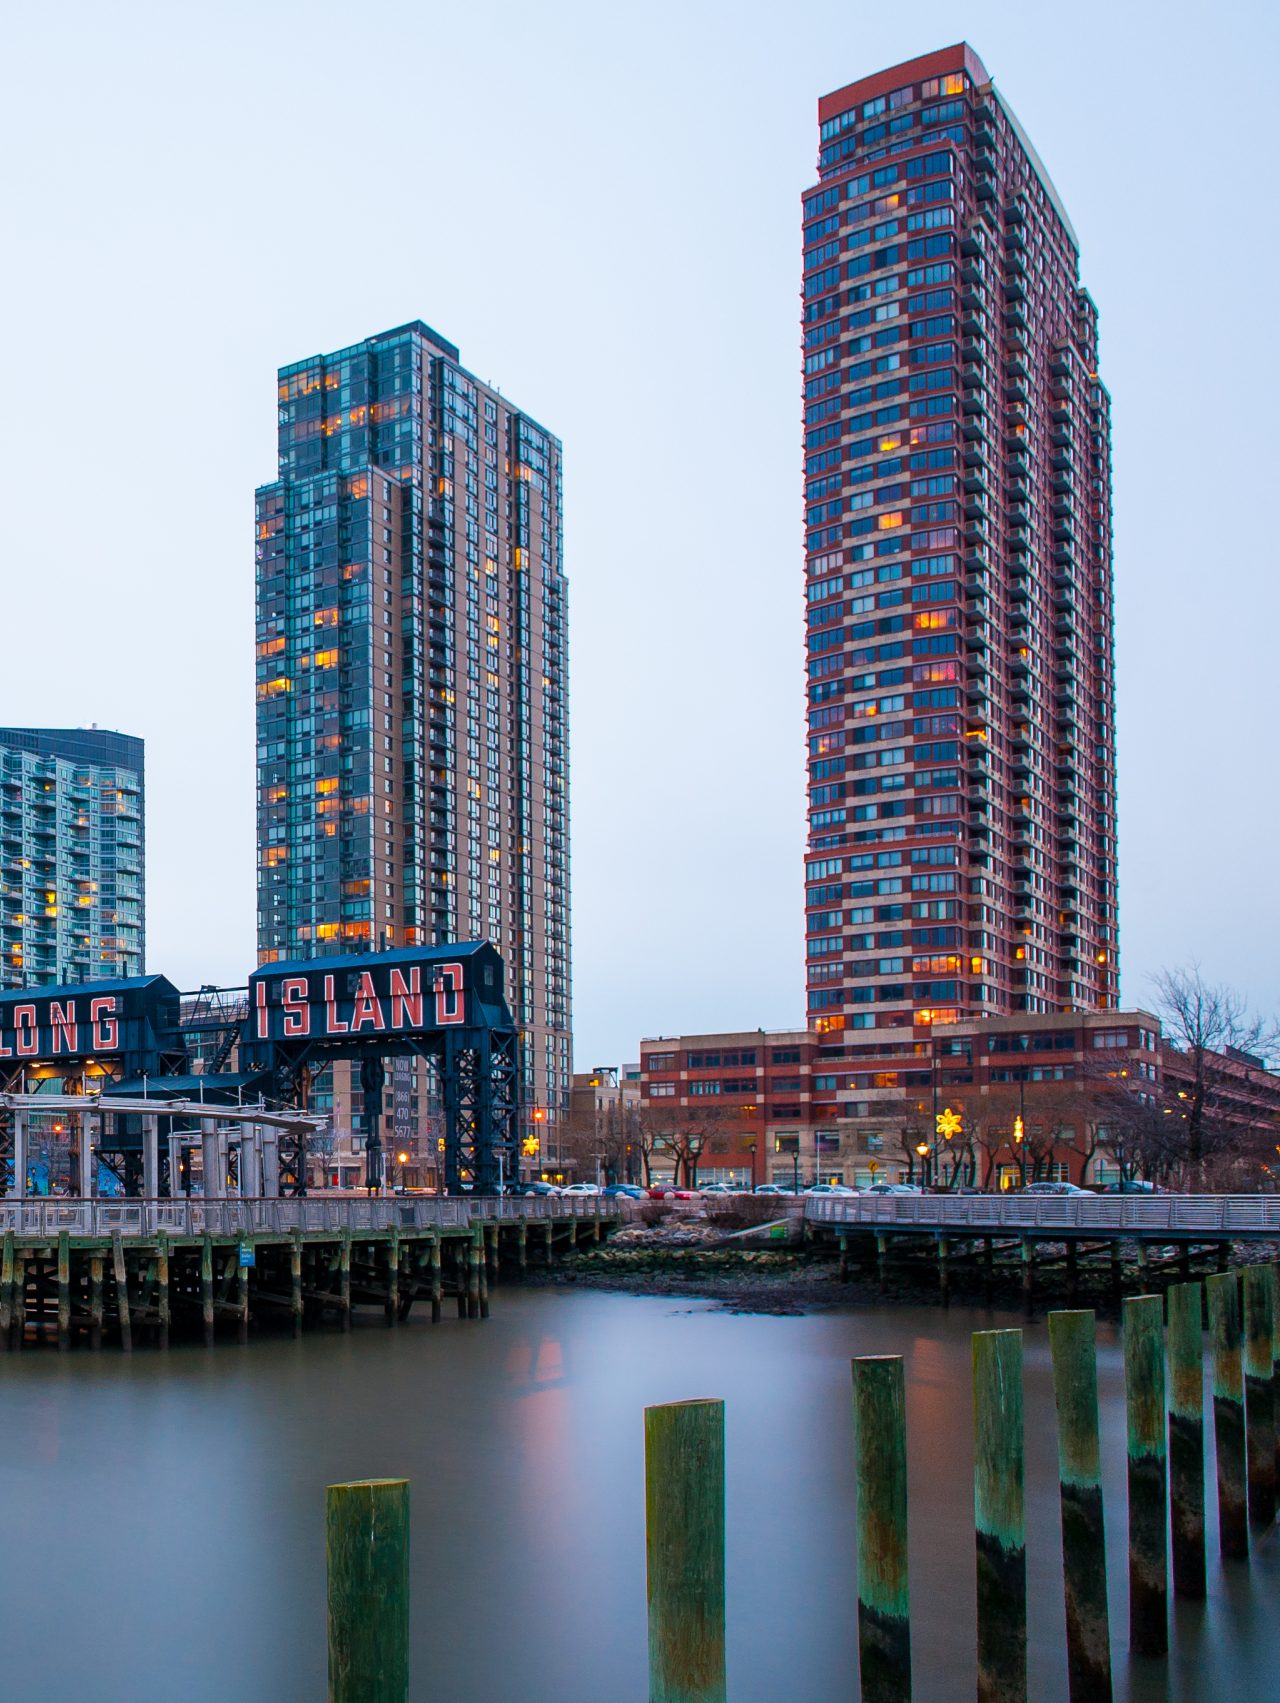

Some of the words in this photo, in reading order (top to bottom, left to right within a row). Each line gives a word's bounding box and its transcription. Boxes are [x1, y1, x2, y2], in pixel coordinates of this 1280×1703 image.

[256, 962, 465, 1038] ISLAND
[396, 1060, 408, 1071] NOW
[396, 1092, 409, 1103] (866)
[397, 1108, 408, 1119] 470
[395, 1126, 410, 1137] 5677
